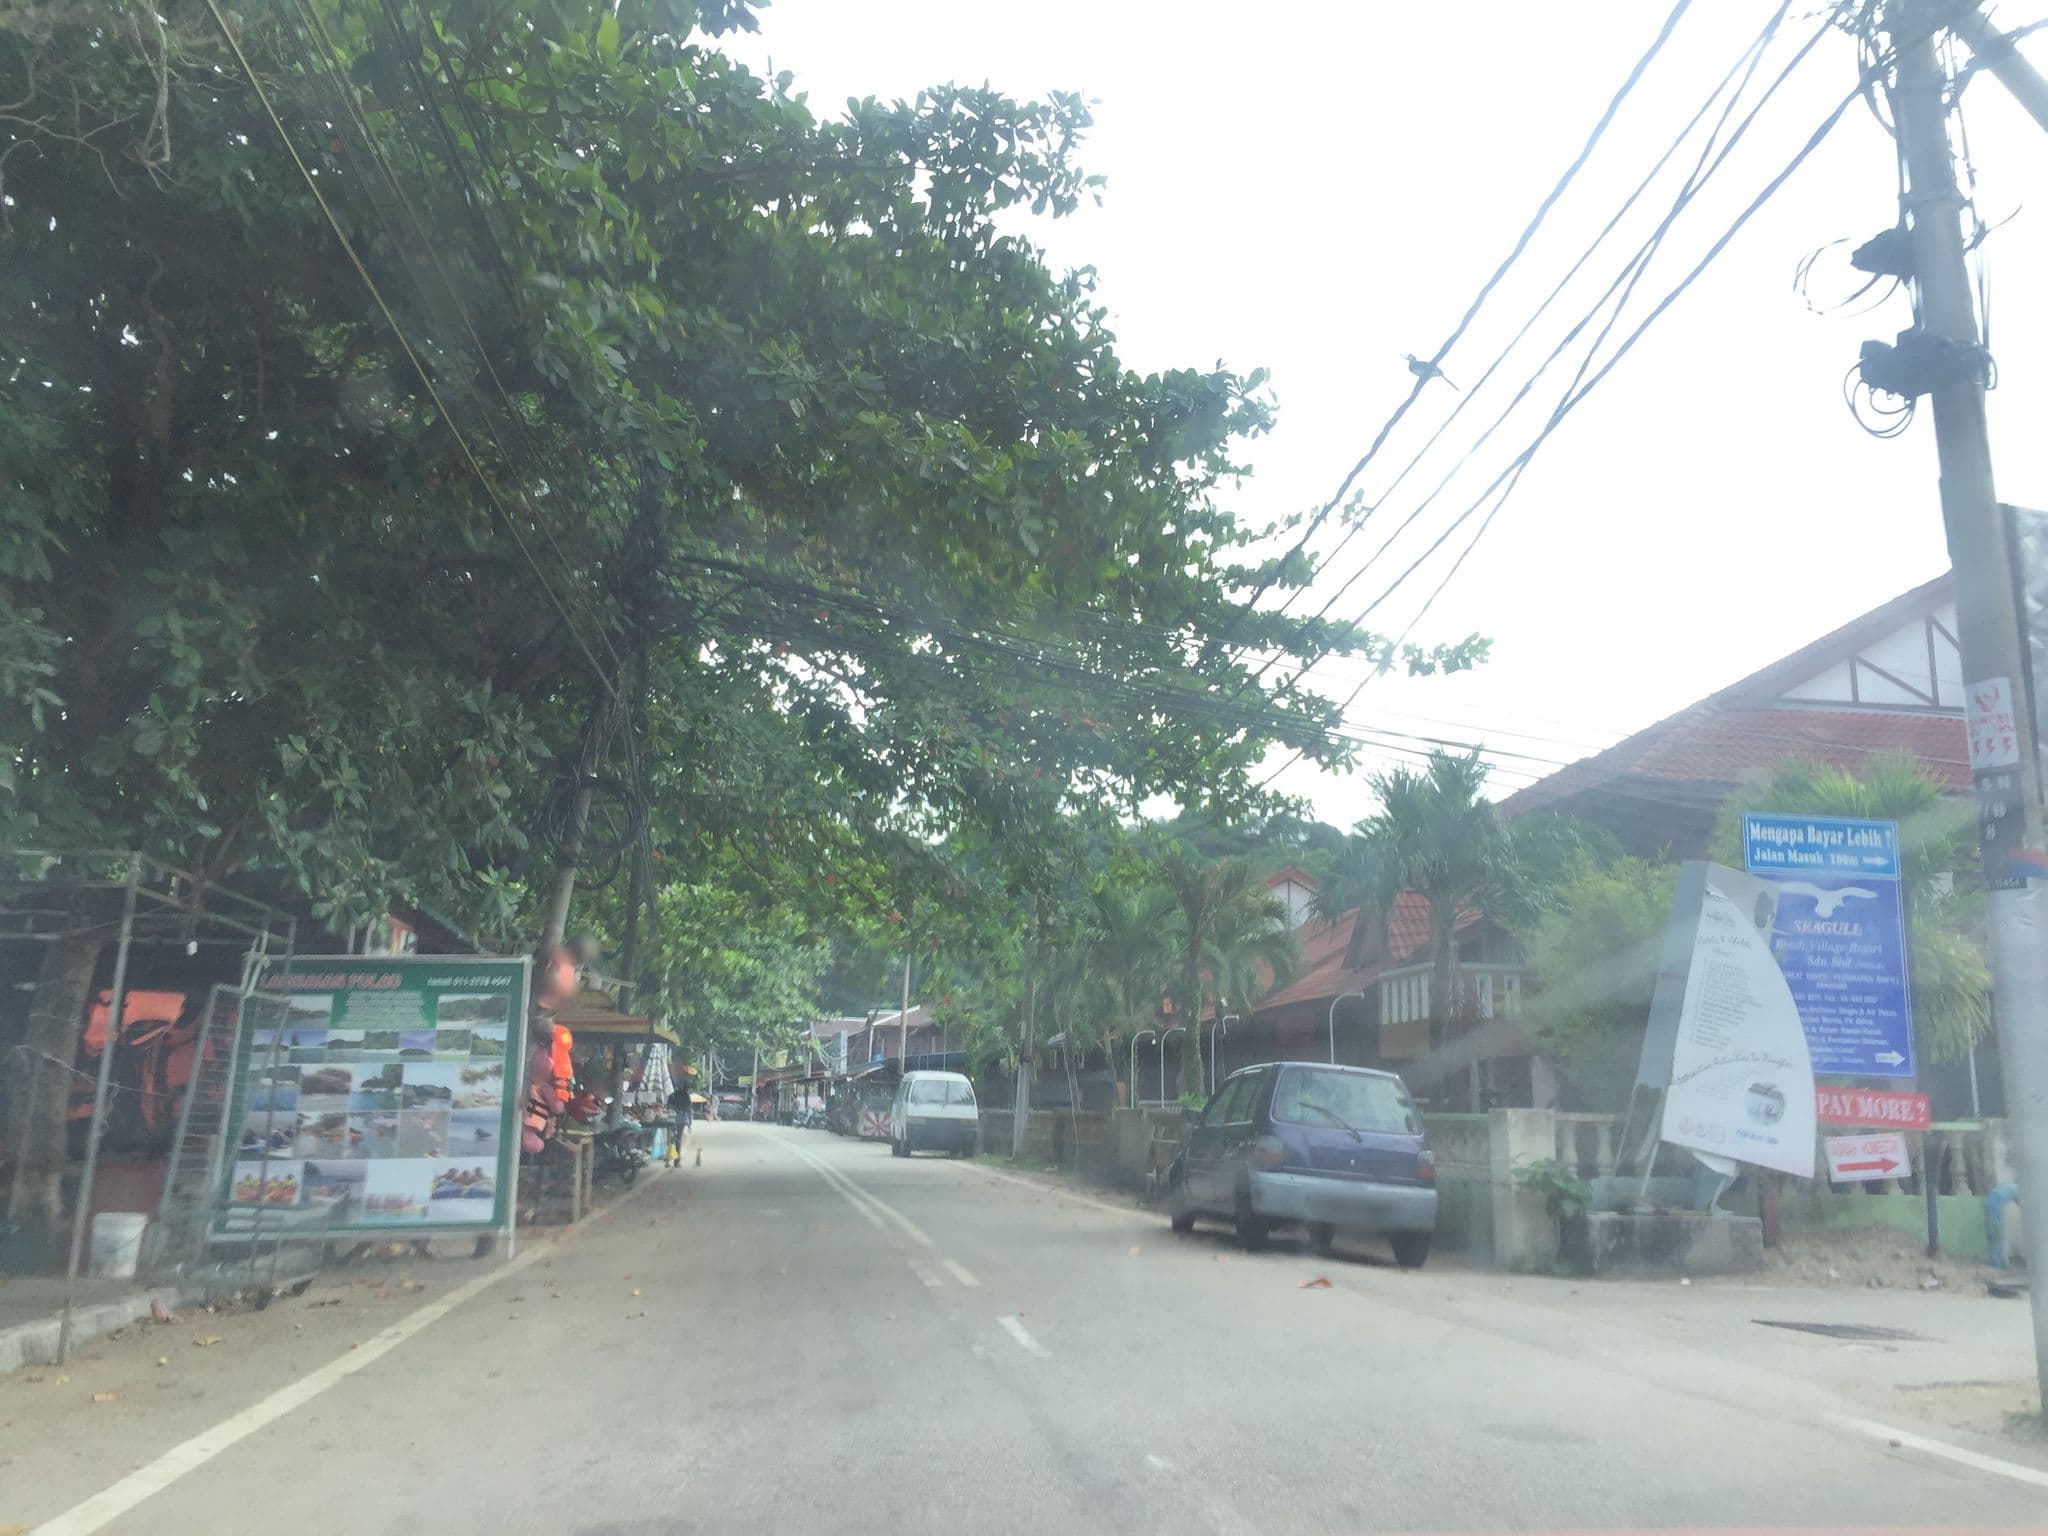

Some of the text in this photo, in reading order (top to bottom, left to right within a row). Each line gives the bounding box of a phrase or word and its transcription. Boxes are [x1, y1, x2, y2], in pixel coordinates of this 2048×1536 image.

[1750, 821, 1804, 847] Mengapa
[1807, 824, 1844, 848] Bayar
[1847, 827, 1882, 848] Lebih
[1754, 847, 1785, 862] Jalan
[1788, 849, 1824, 864] Masuk
[1793, 919, 1862, 936] SEAGULL
[1808, 955, 1827, 968] Sdn
[1831, 955, 1853, 968] Bhd
[1816, 1092, 1927, 1122] PAY MORE ?
